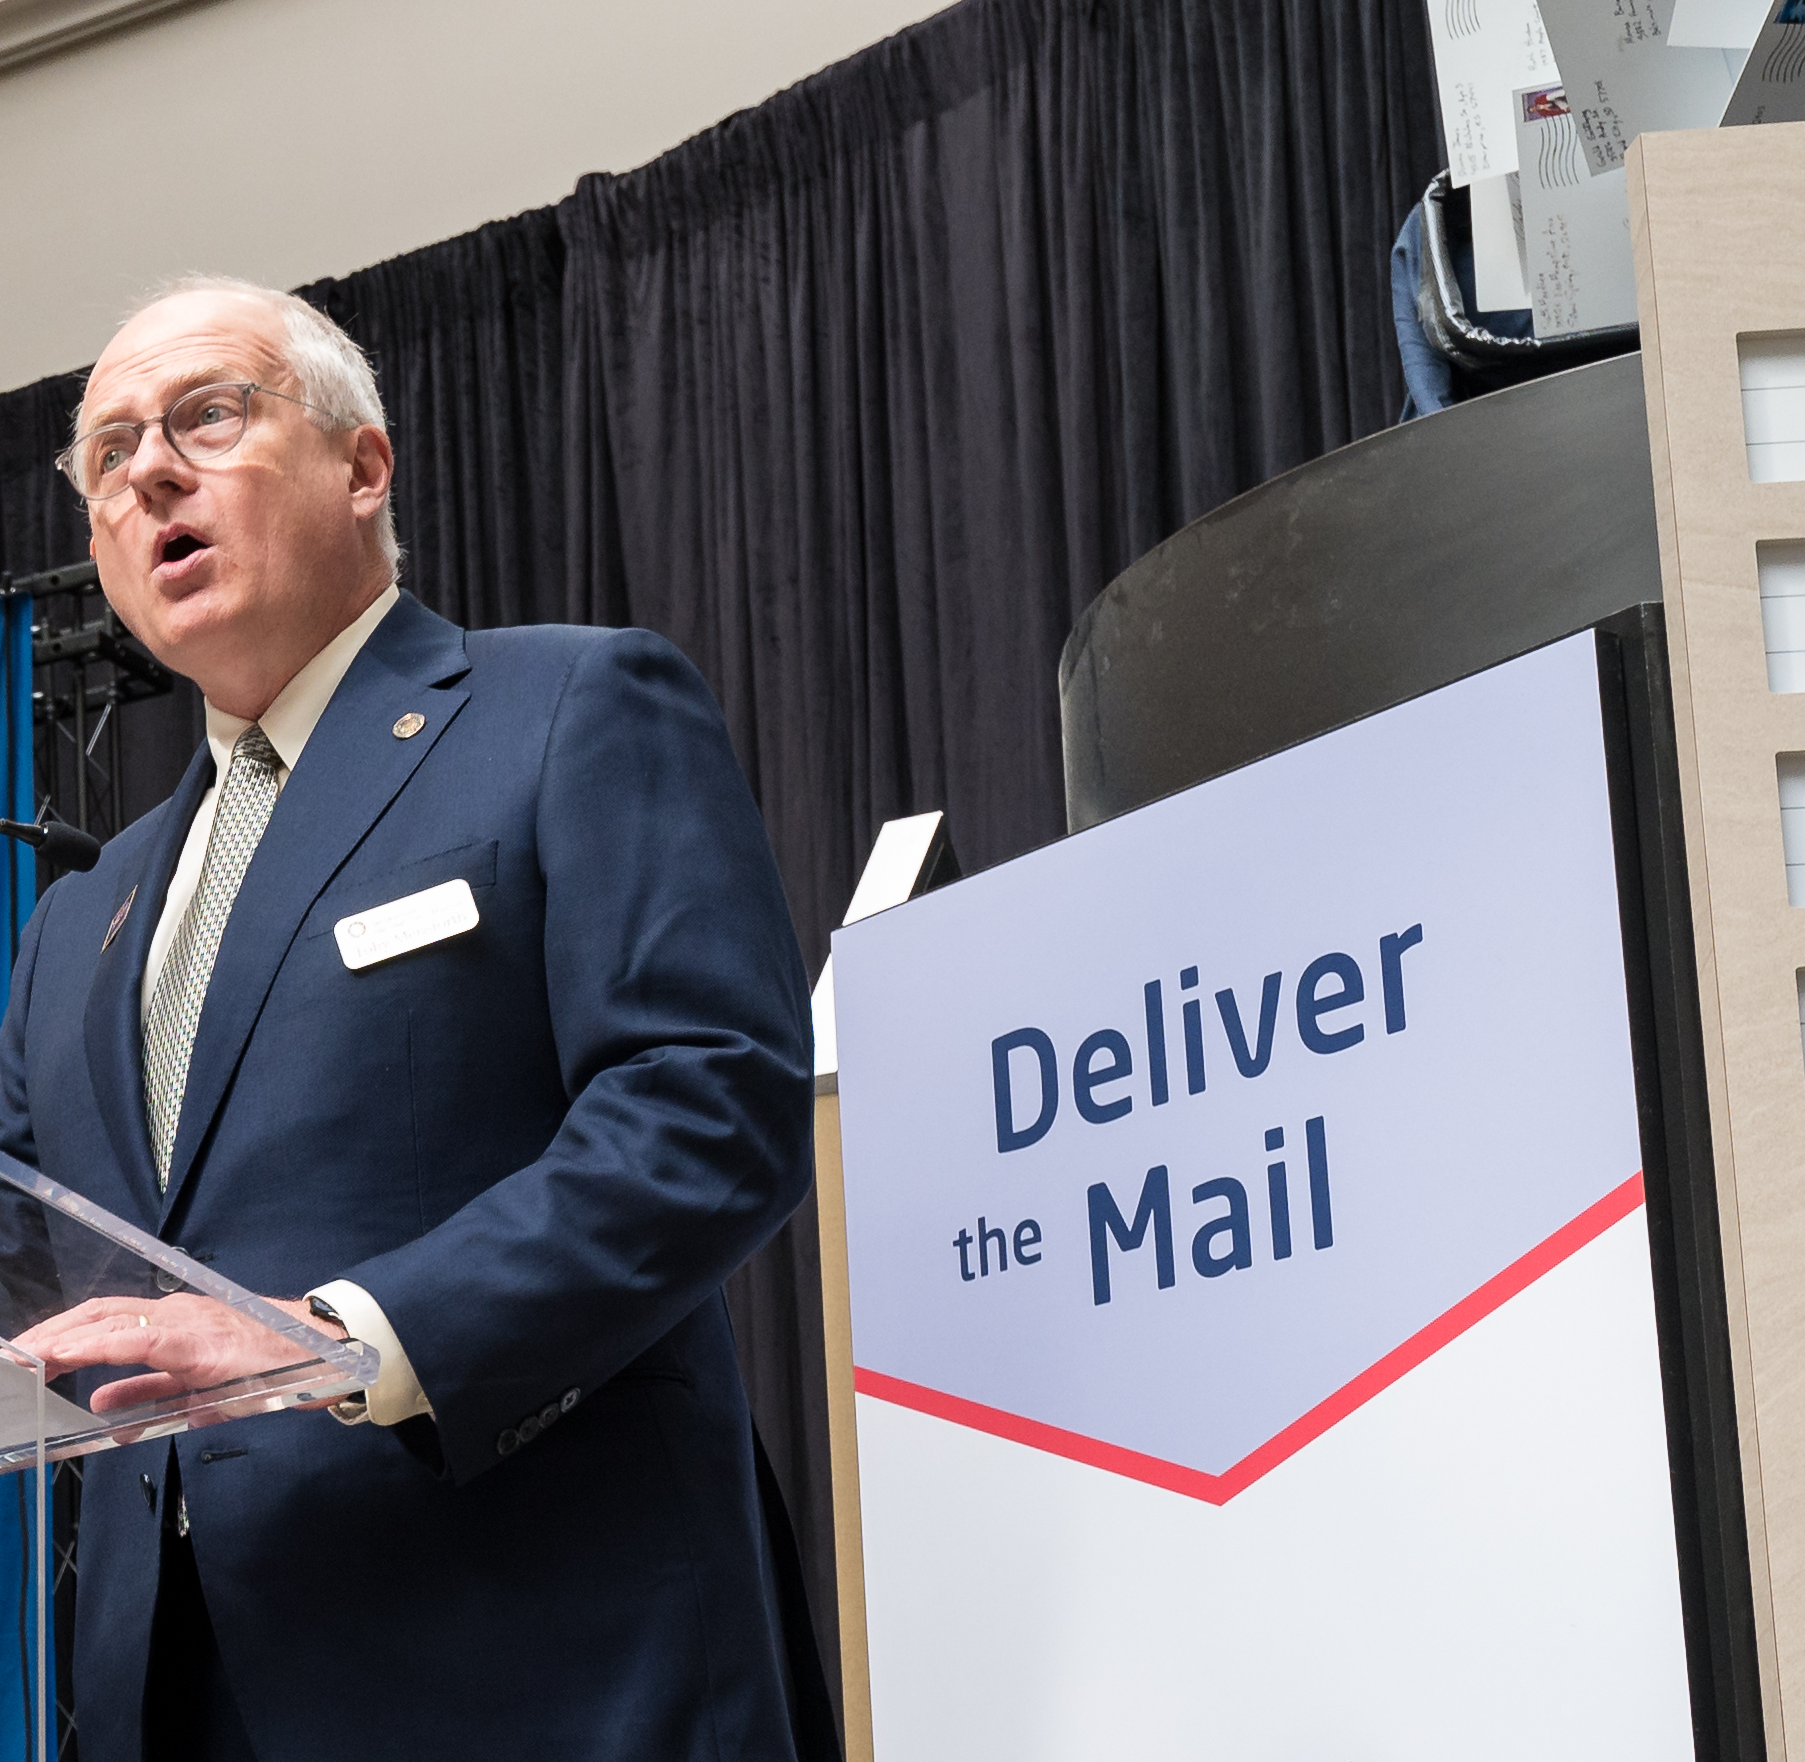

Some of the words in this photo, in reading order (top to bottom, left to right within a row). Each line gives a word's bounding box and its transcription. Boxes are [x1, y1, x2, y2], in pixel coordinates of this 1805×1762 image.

[990, 923, 1423, 1153] Deliver
[952, 1217, 1043, 1283] the
[1087, 1117, 1335, 1306] Mail
